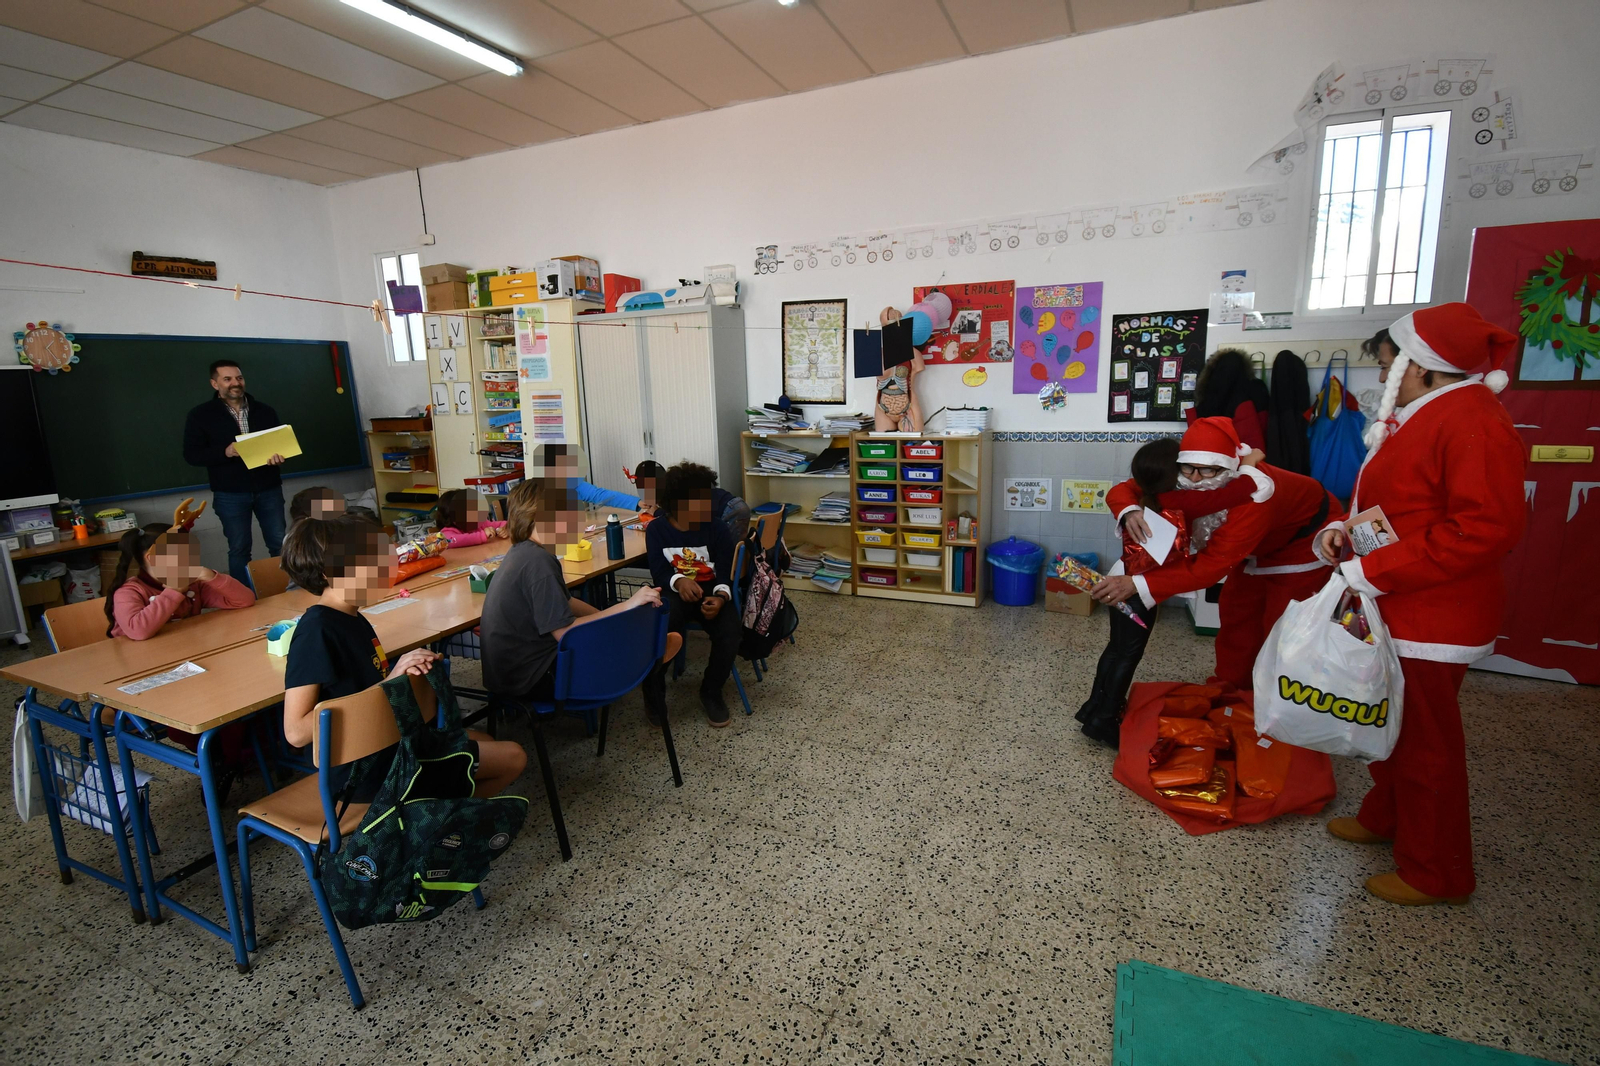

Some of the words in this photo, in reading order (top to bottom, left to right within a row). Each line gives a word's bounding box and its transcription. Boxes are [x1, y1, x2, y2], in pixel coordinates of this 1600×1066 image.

[163, 264, 186, 273] ALTO
[187, 267, 214, 275] GENAL
[450, 322, 460, 338] V
[1118, 316, 1188, 334] NORMAS
[1141, 332, 1160, 343] DE
[1123, 342, 1187, 358] CLASE
[443, 357, 453, 372] X
[435, 391, 445, 406] L
[458, 390, 467, 406] C
[1278, 675, 1388, 728] wuau!
